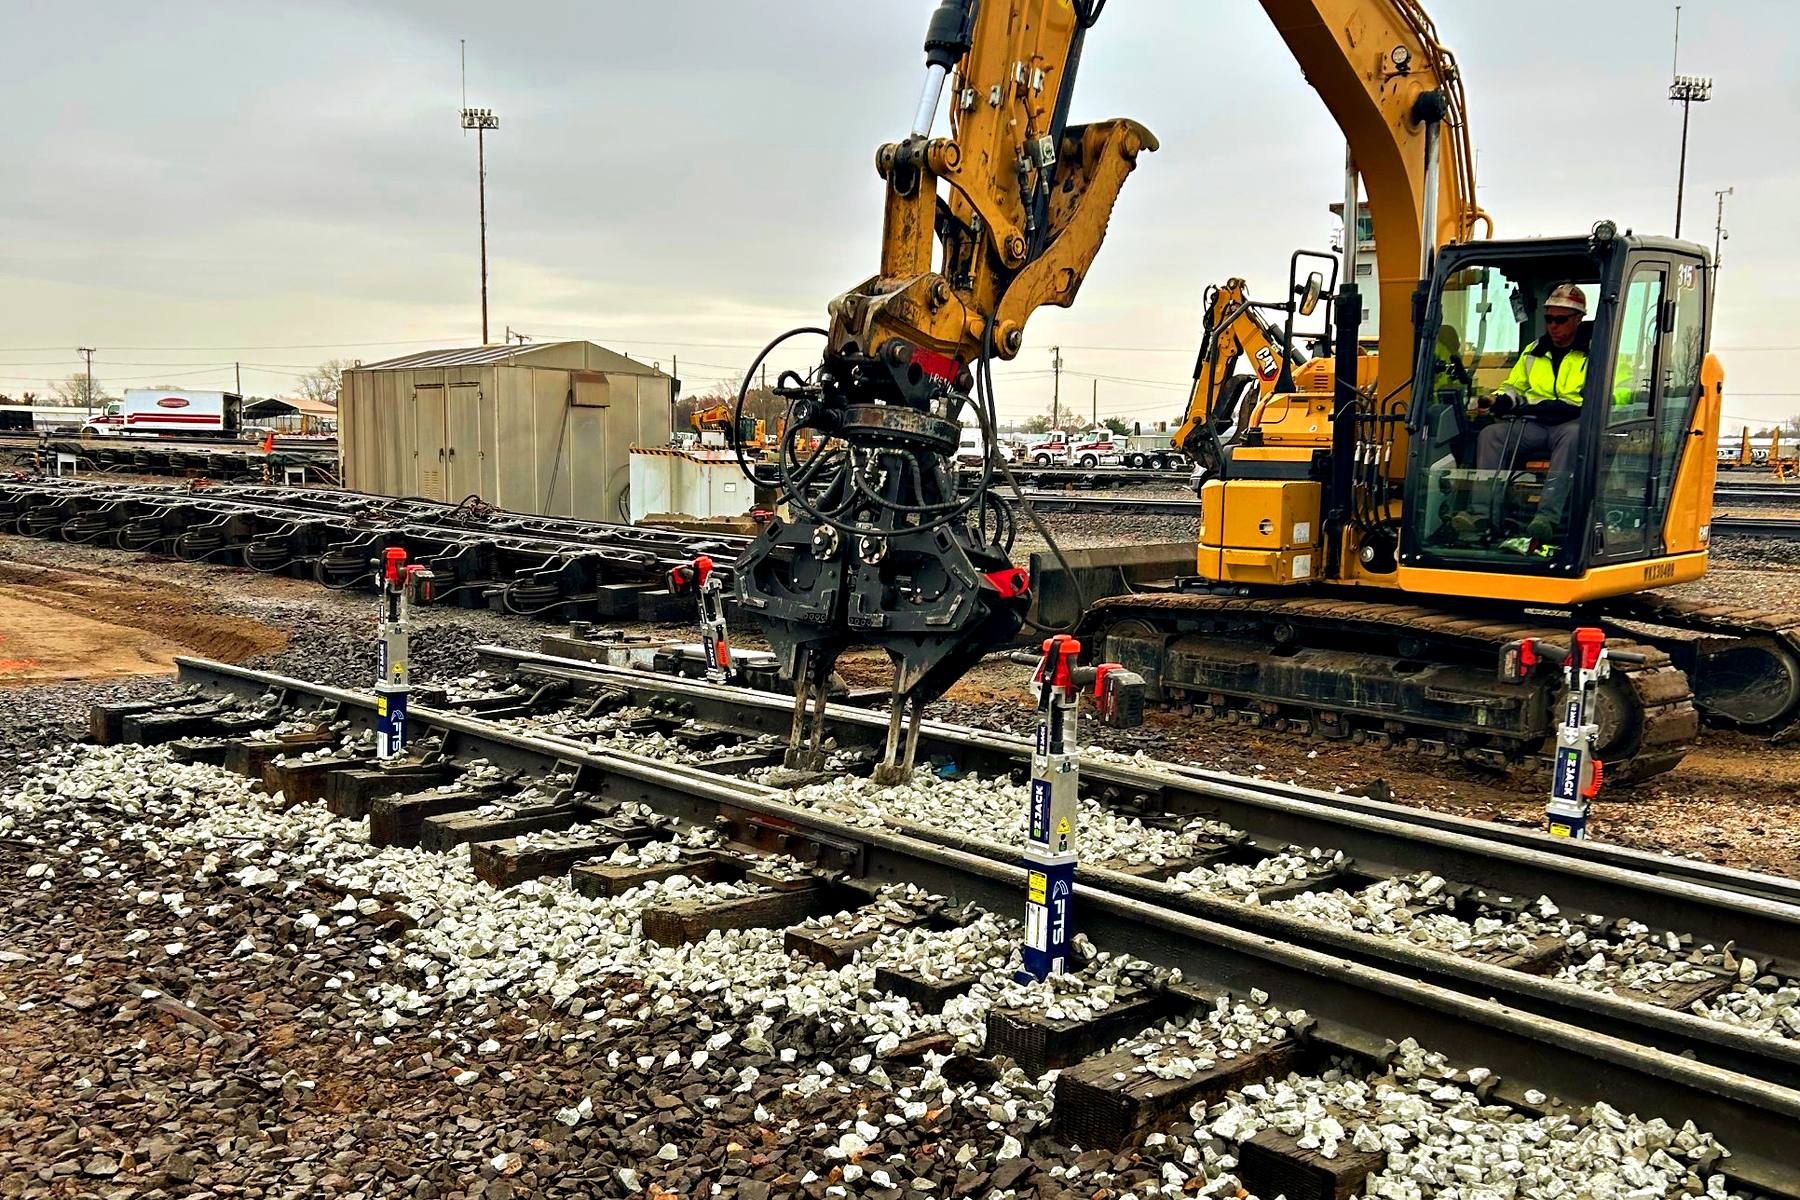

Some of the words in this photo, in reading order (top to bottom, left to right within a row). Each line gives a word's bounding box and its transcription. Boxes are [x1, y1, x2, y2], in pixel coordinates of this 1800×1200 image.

[1678, 263, 1693, 287] 315
[1255, 346, 1278, 375] CAT
[392, 721, 402, 752] FTS
[1052, 898, 1066, 945] FTS
